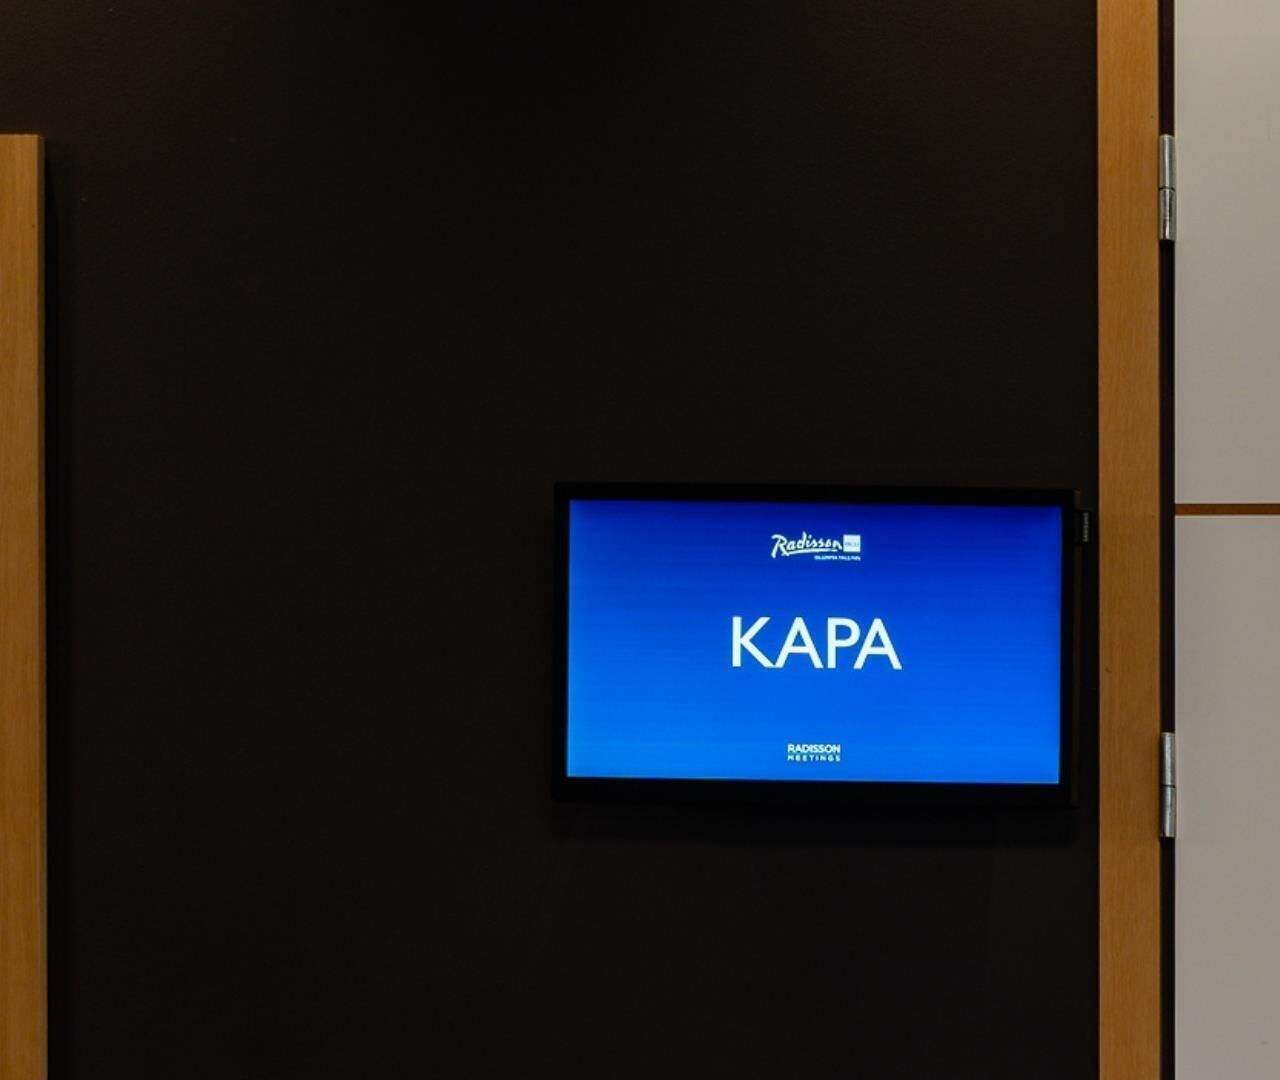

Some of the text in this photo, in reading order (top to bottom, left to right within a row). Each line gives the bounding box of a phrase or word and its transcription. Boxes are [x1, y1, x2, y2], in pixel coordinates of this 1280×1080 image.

[771, 531, 843, 559] Radisson
[732, 616, 903, 670] KAPA
[787, 744, 841, 753] RADISSON
[787, 754, 841, 762] MEETINGS
